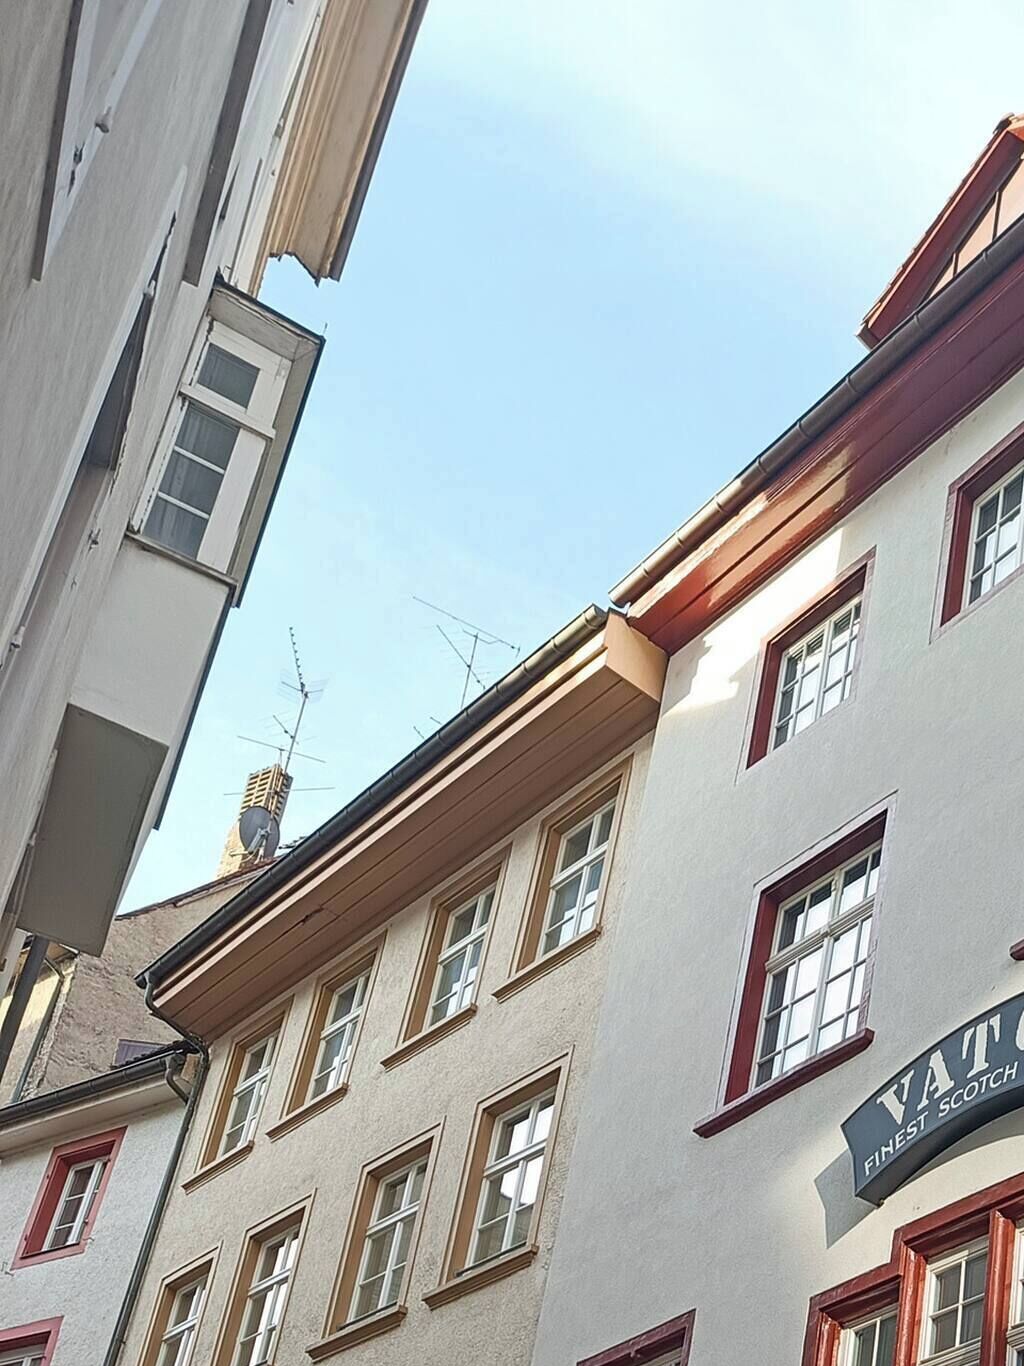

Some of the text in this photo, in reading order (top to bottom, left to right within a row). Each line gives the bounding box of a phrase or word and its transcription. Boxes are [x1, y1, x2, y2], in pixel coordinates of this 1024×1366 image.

[863, 1110, 929, 1177] FINEST
[937, 1061, 1019, 1118] SCOTCH
[876, 1013, 1001, 1126] VAT
